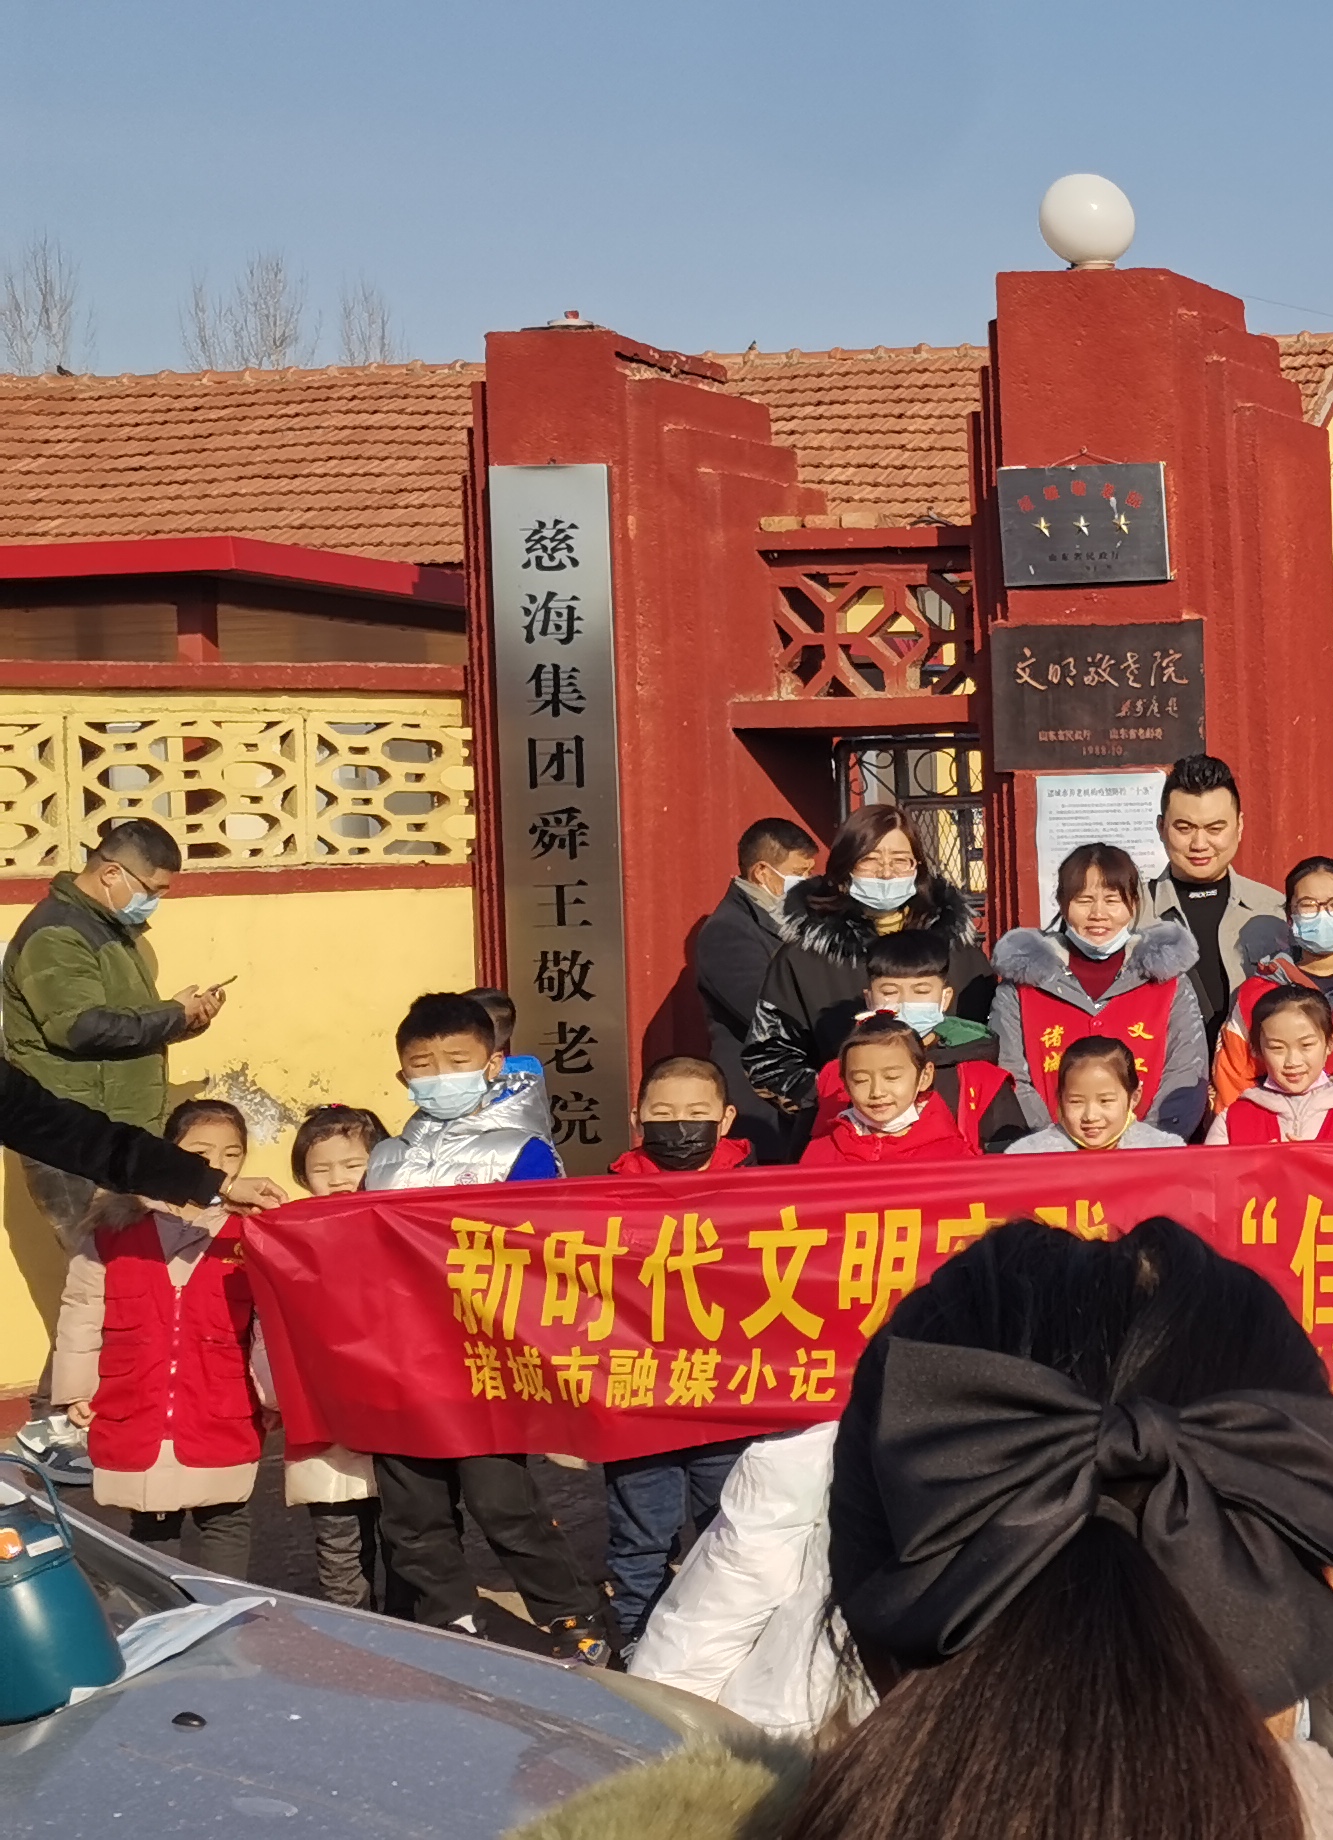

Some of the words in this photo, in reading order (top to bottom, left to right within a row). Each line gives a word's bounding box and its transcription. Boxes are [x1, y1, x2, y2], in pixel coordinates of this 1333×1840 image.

[1016, 647, 1189, 691] 文明敬老院
[519, 518, 603, 1146] 慈海集团舜王敬老院
[447, 1200, 1107, 1342] 新时代文明
